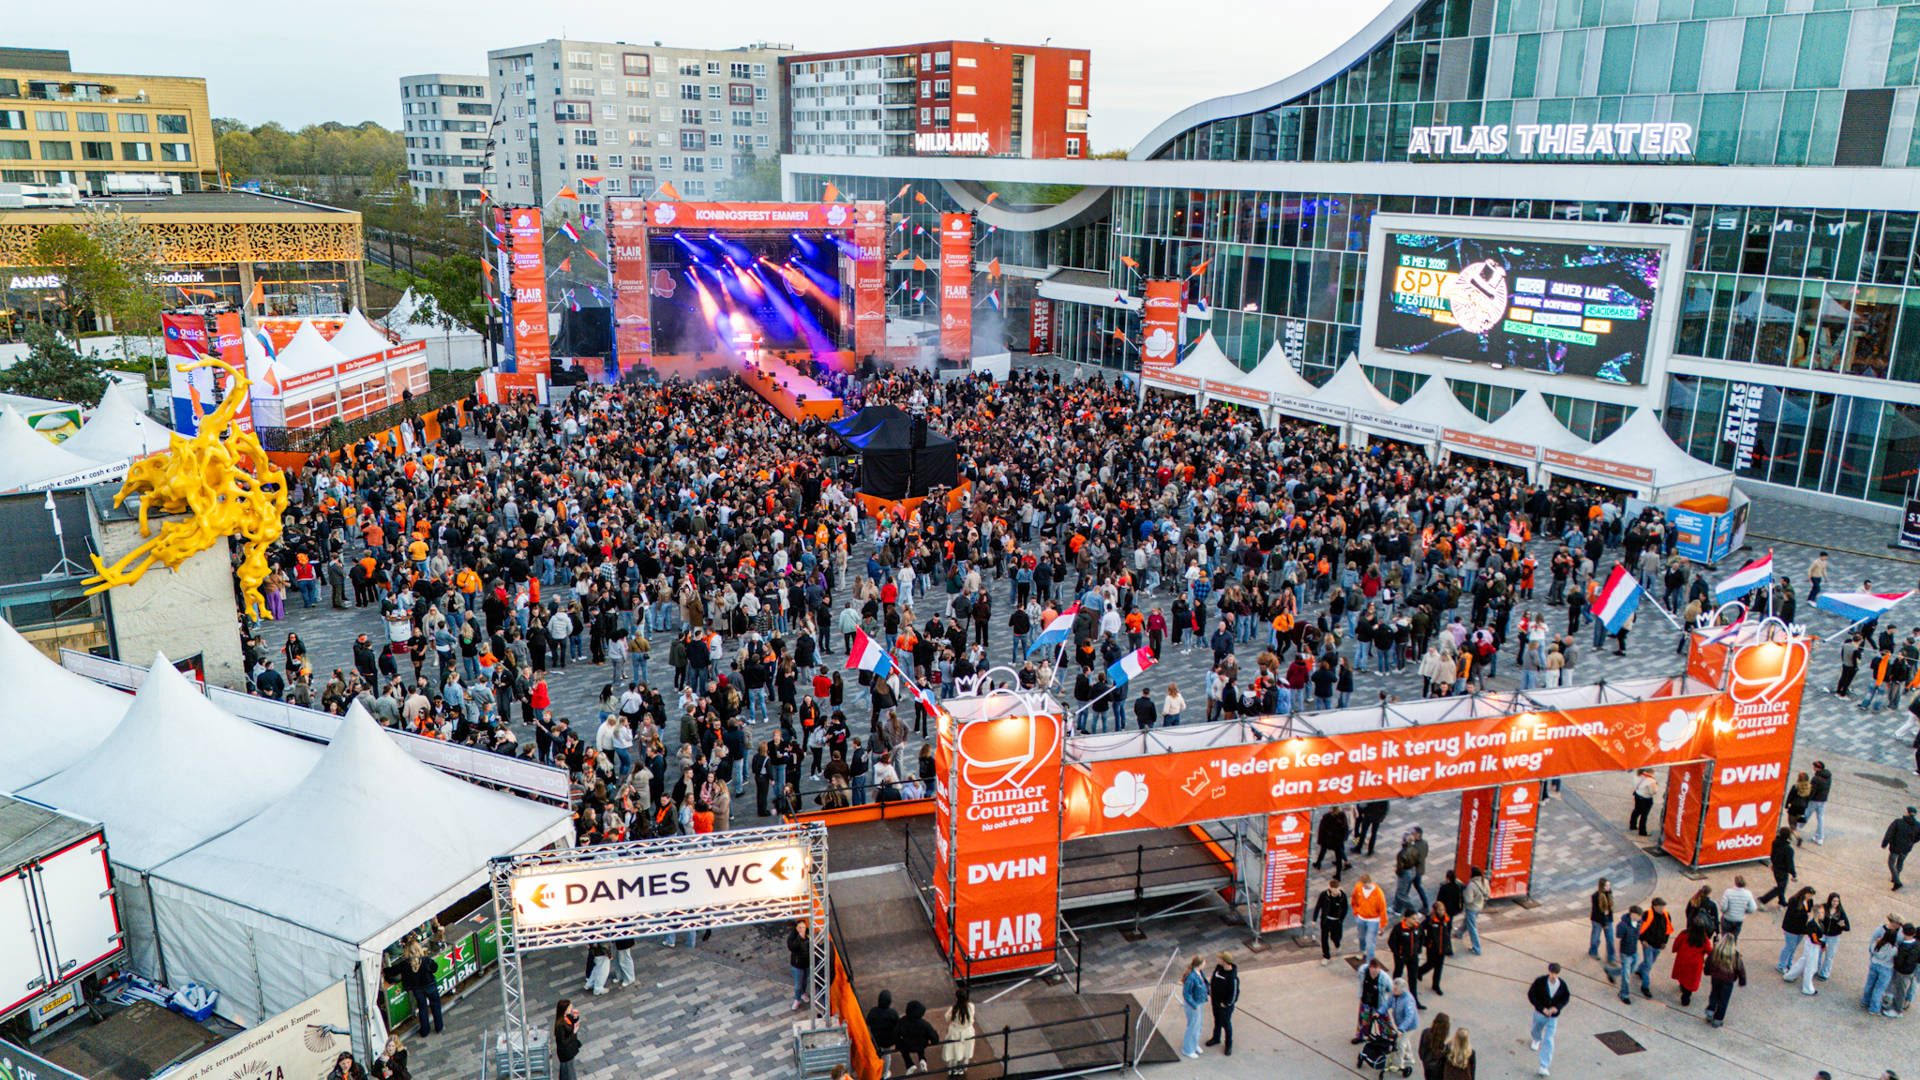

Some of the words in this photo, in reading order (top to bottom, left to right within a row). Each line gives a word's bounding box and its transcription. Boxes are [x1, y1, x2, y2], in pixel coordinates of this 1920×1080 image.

[915, 132, 989, 151] WILDLANDS
[1408, 125, 1508, 154] ATLAS
[1516, 124, 1692, 154] THEATER
[696, 210, 770, 220] KONINGSFEEST
[772, 210, 808, 220] EMMEN
[616, 246, 641, 256] FLAIR
[860, 246, 880, 256] FLAIR
[1402, 255, 1410, 266] 15
[1412, 256, 1426, 268] MEI
[517, 288, 542, 298] FLAIR
[945, 286, 968, 296] FLAIR
[1401, 270, 1447, 296] SPY
[1551, 282, 1582, 298] SILVER
[1584, 286, 1611, 301] LAKE
[1399, 292, 1445, 309] FESTIVAL
[180, 328, 204, 337] Quick
[1724, 383, 1746, 443] ATLAS
[1736, 386, 1764, 469] THEATER
[64, 476, 80, 486] cash
[89, 469, 104, 478] cash
[113, 463, 128, 472] cash
[1575, 457, 1587, 466] bar
[1604, 463, 1618, 472] bar
[1635, 468, 1650, 478] bar
[1734, 700, 1790, 716] Emmer
[1728, 713, 1790, 730] Courant
[1294, 750, 1344, 768] keer
[1348, 744, 1377, 763] als
[1382, 740, 1398, 758] ik
[1404, 733, 1459, 756] terug
[1465, 729, 1506, 749] kom
[1510, 726, 1528, 743] in
[1533, 721, 1608, 741] Emmen,
[1271, 778, 1312, 798] dan
[1317, 774, 1353, 794] zeg
[1358, 771, 1383, 788] ik:
[1387, 763, 1431, 785] Hier
[1435, 760, 1477, 778] kom
[1480, 756, 1498, 772] ik
[1720, 762, 1781, 785] DVHN
[971, 784, 1046, 805] Emmer
[966, 798, 1049, 821] Courant
[982, 822, 994, 832] Nu
[994, 820, 1007, 830] ook
[1008, 818, 1019, 828] als
[1020, 815, 1034, 826] app
[1716, 834, 1763, 850] webba
[968, 856, 1046, 884] DVHN
[566, 872, 690, 905] DAMES
[706, 863, 762, 889] WC
[968, 913, 1042, 951] FLAIR
[215, 1031, 275, 1068] terrassenfestival
[276, 1025, 289, 1034] van
[291, 1008, 320, 1026] Emmen.
